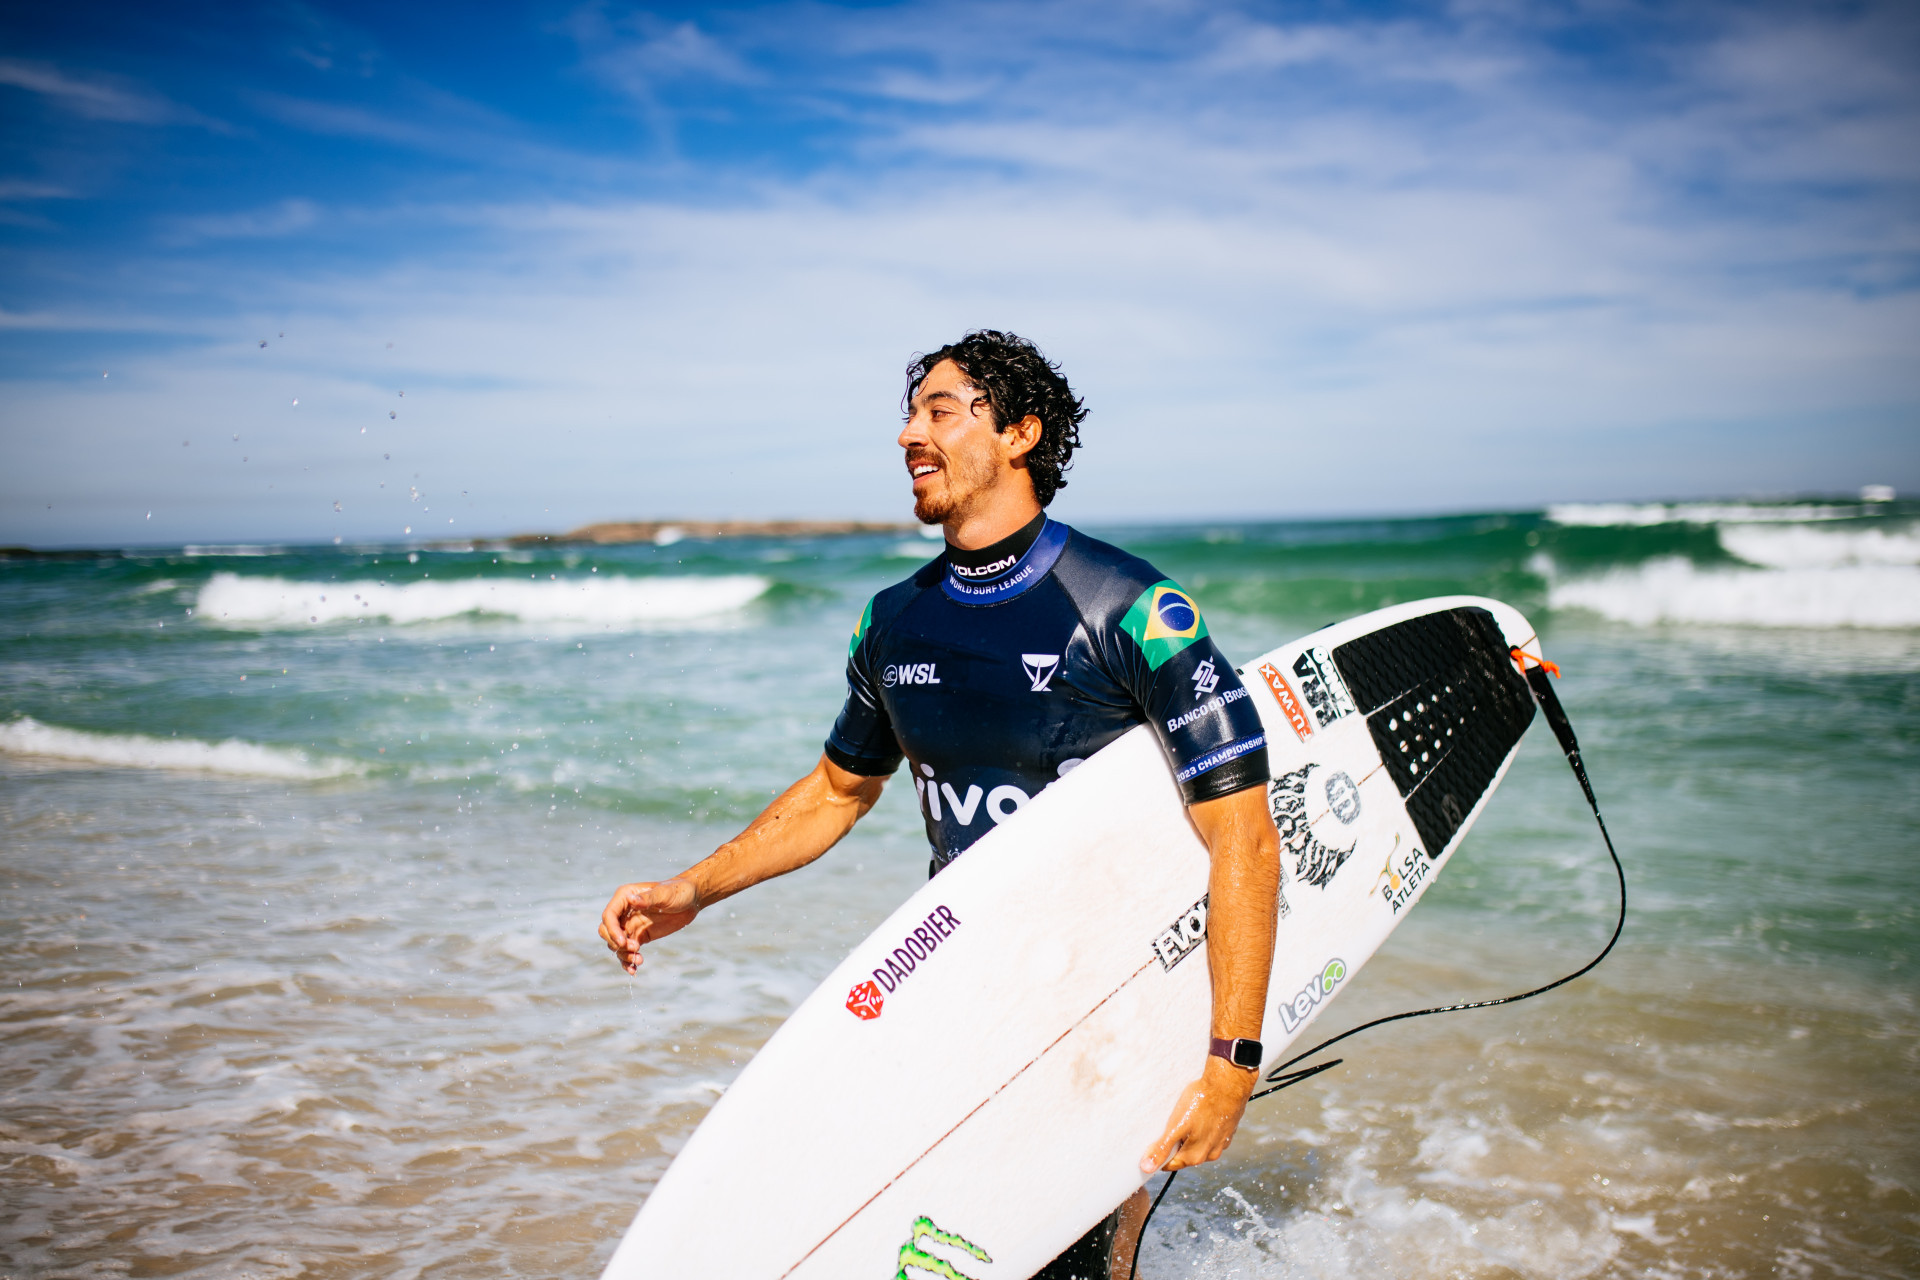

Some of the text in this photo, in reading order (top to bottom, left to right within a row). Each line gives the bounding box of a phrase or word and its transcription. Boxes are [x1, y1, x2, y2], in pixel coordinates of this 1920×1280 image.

[950, 555, 1016, 576] VOLCOM
[950, 565, 1034, 595] WORLD SURF LEAGUE
[899, 663, 940, 685] WSL
[1167, 687, 1249, 733] BANCO DO BRAS
[1176, 767, 1197, 782] 2023
[1392, 862, 1430, 915] ATLETA
[872, 905, 961, 994] DADOBIER
[1156, 902, 1208, 966] EVO
